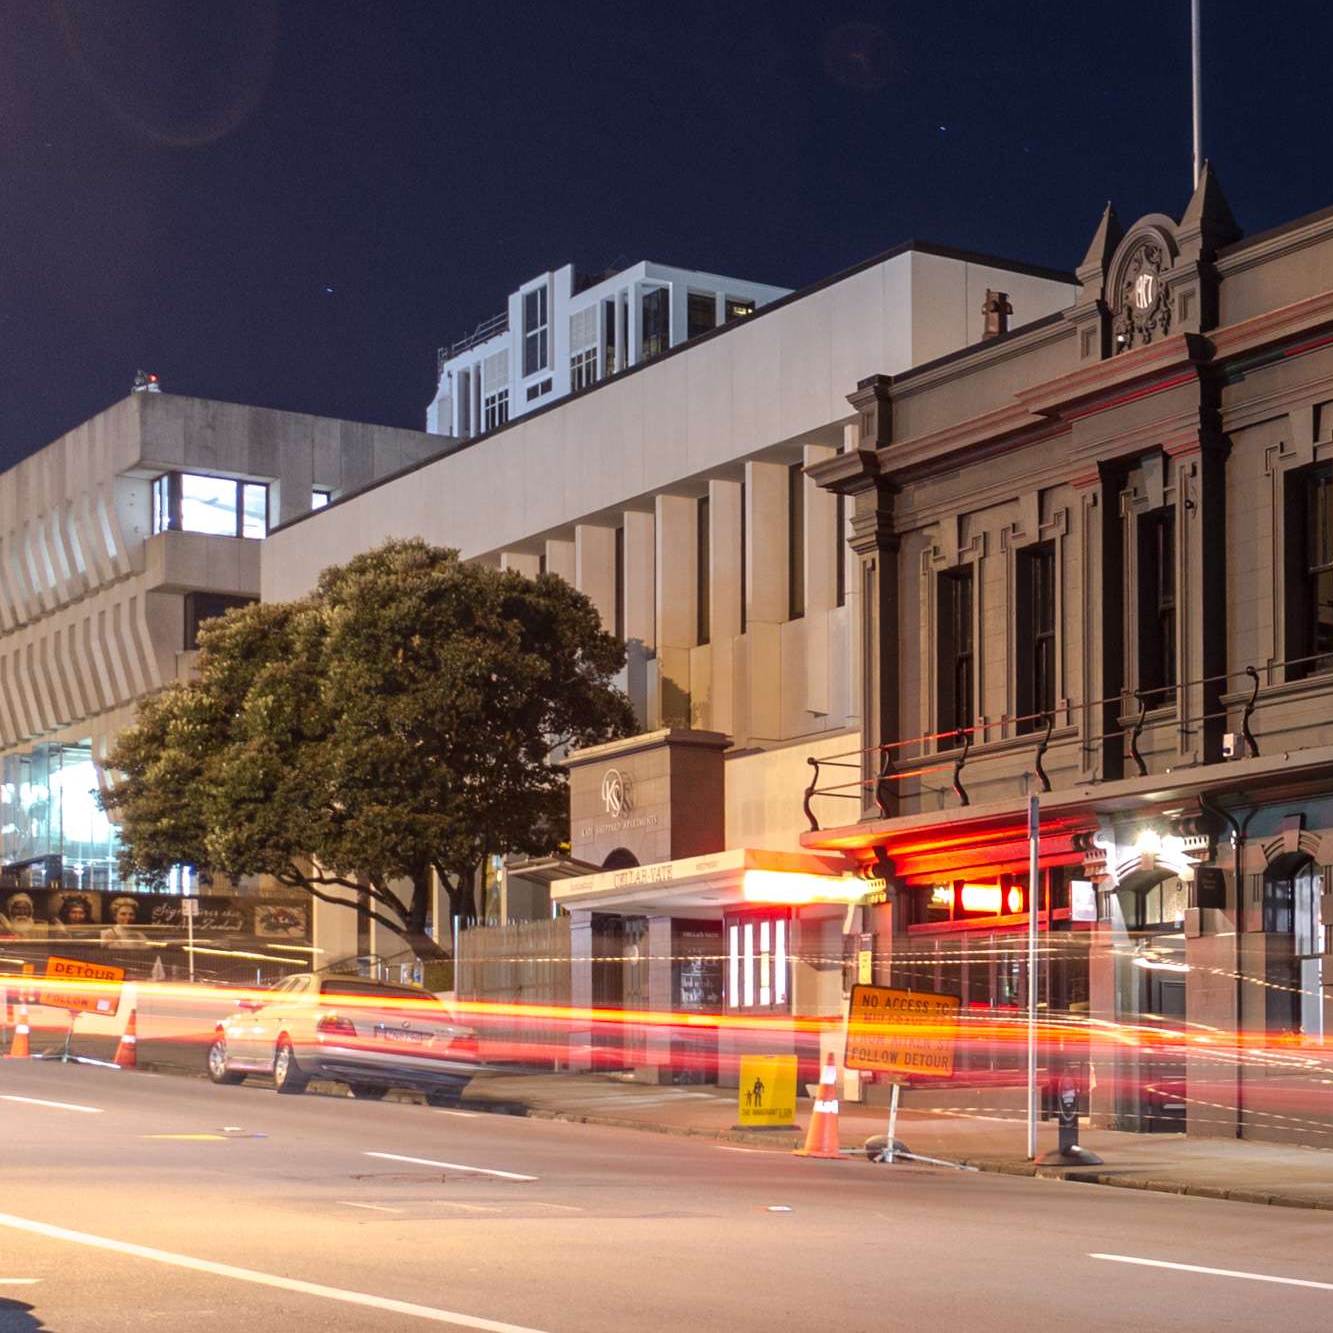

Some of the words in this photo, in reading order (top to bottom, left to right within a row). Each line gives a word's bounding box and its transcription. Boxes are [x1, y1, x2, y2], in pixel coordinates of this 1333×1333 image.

[55, 962, 116, 981] DETOUR
[862, 995, 879, 1008] NO
[884, 996, 930, 1014] ACCESS
[935, 1002, 950, 1016] TO
[850, 1047, 899, 1065] FOLLOW
[903, 1052, 950, 1068] DETOUR
